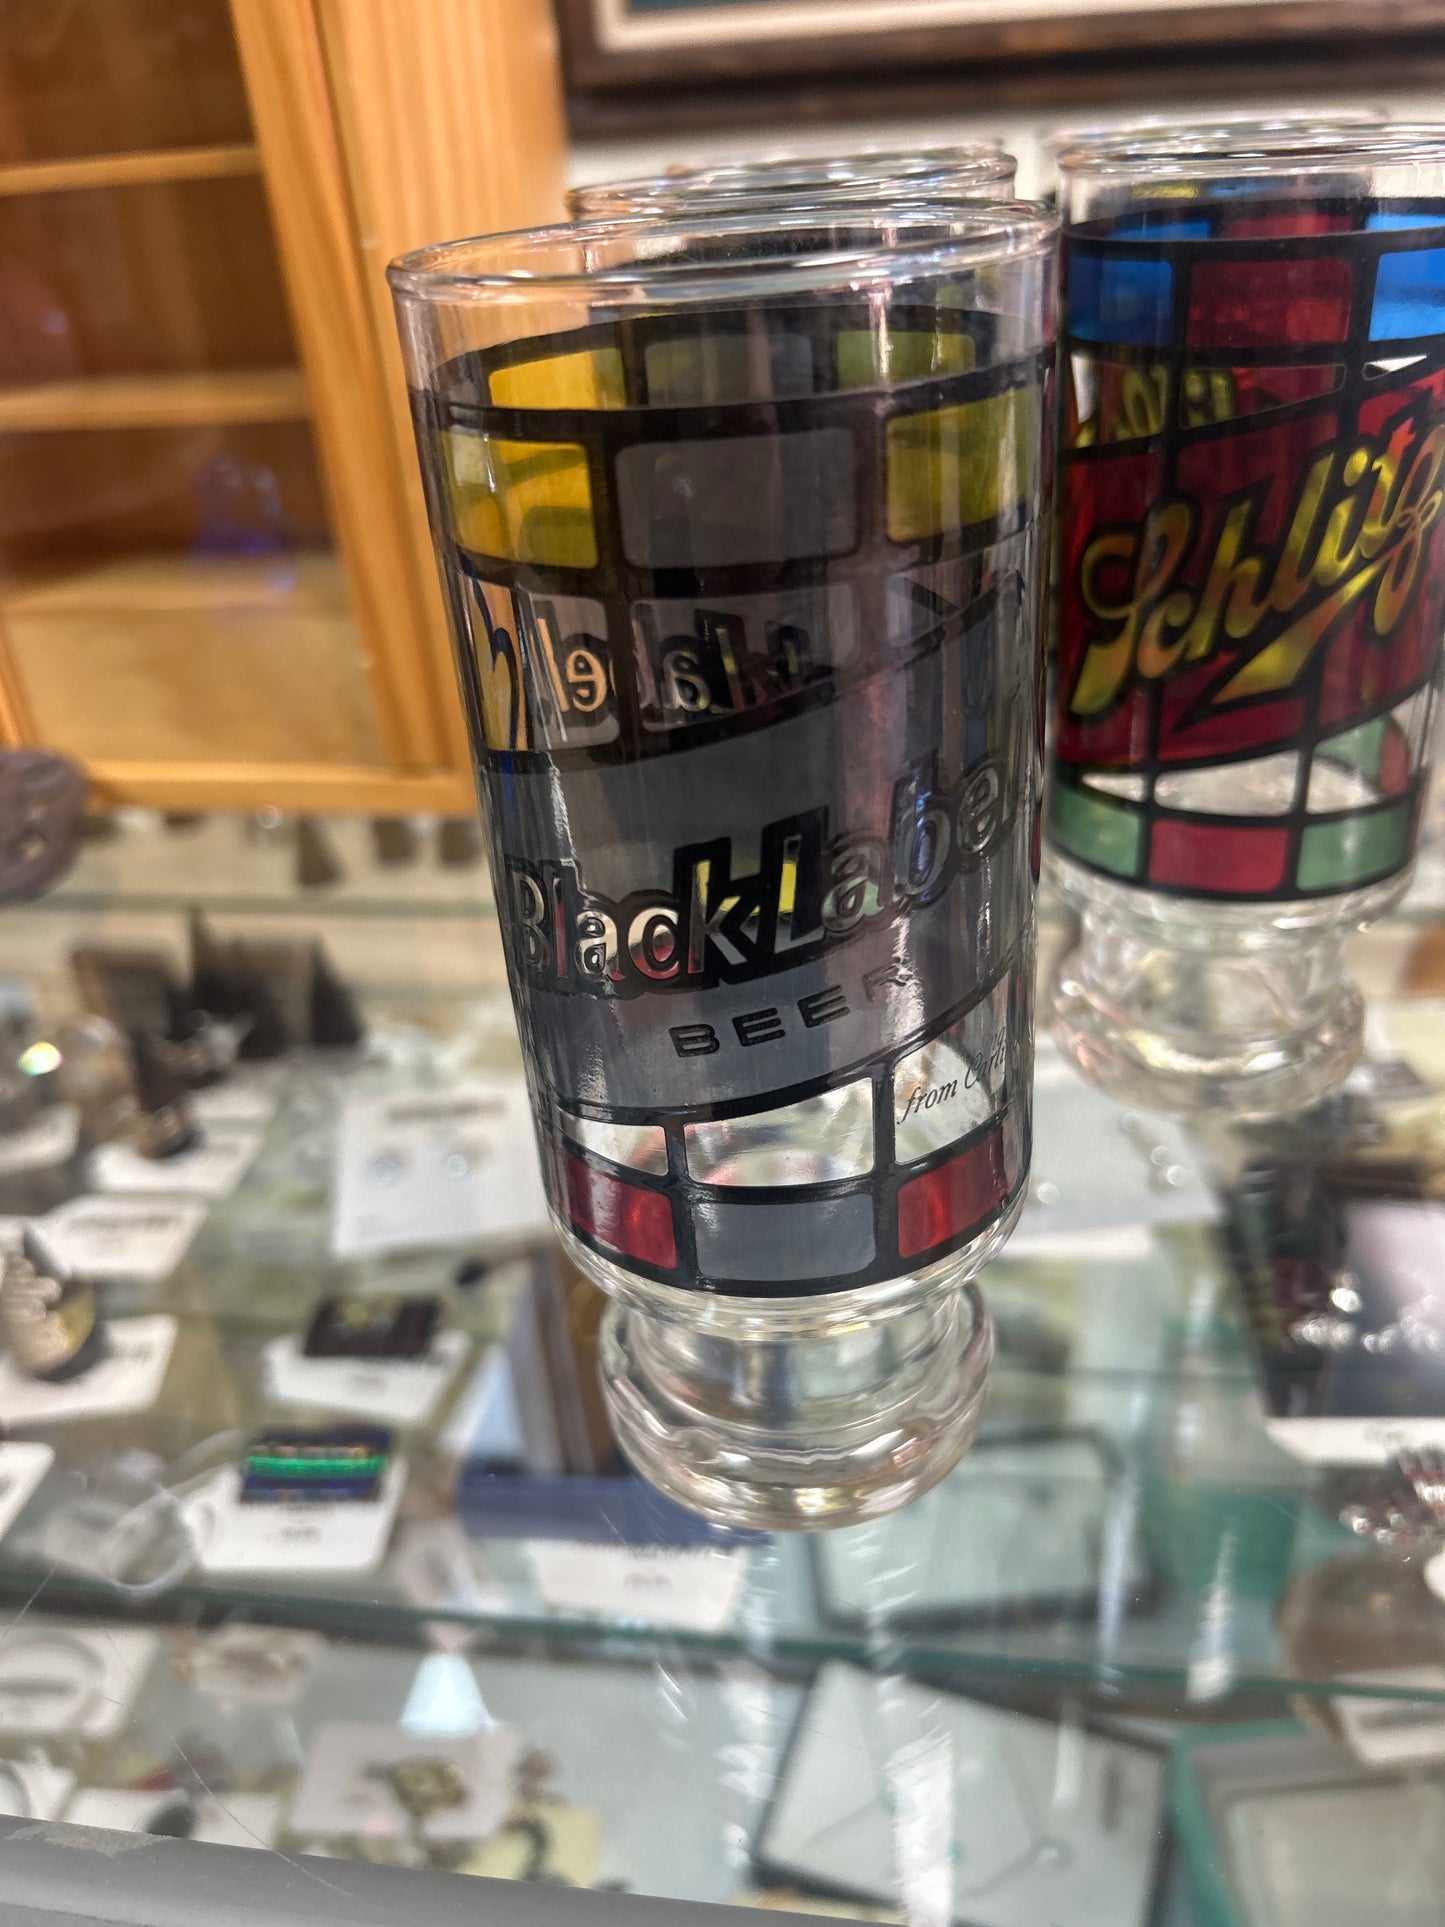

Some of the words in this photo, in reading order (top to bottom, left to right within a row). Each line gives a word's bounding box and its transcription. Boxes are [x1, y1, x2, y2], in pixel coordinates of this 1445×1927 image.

[1071, 418, 1445, 714] Schlitz
[506, 848, 752, 988] Black
[896, 1079, 958, 1125] from
